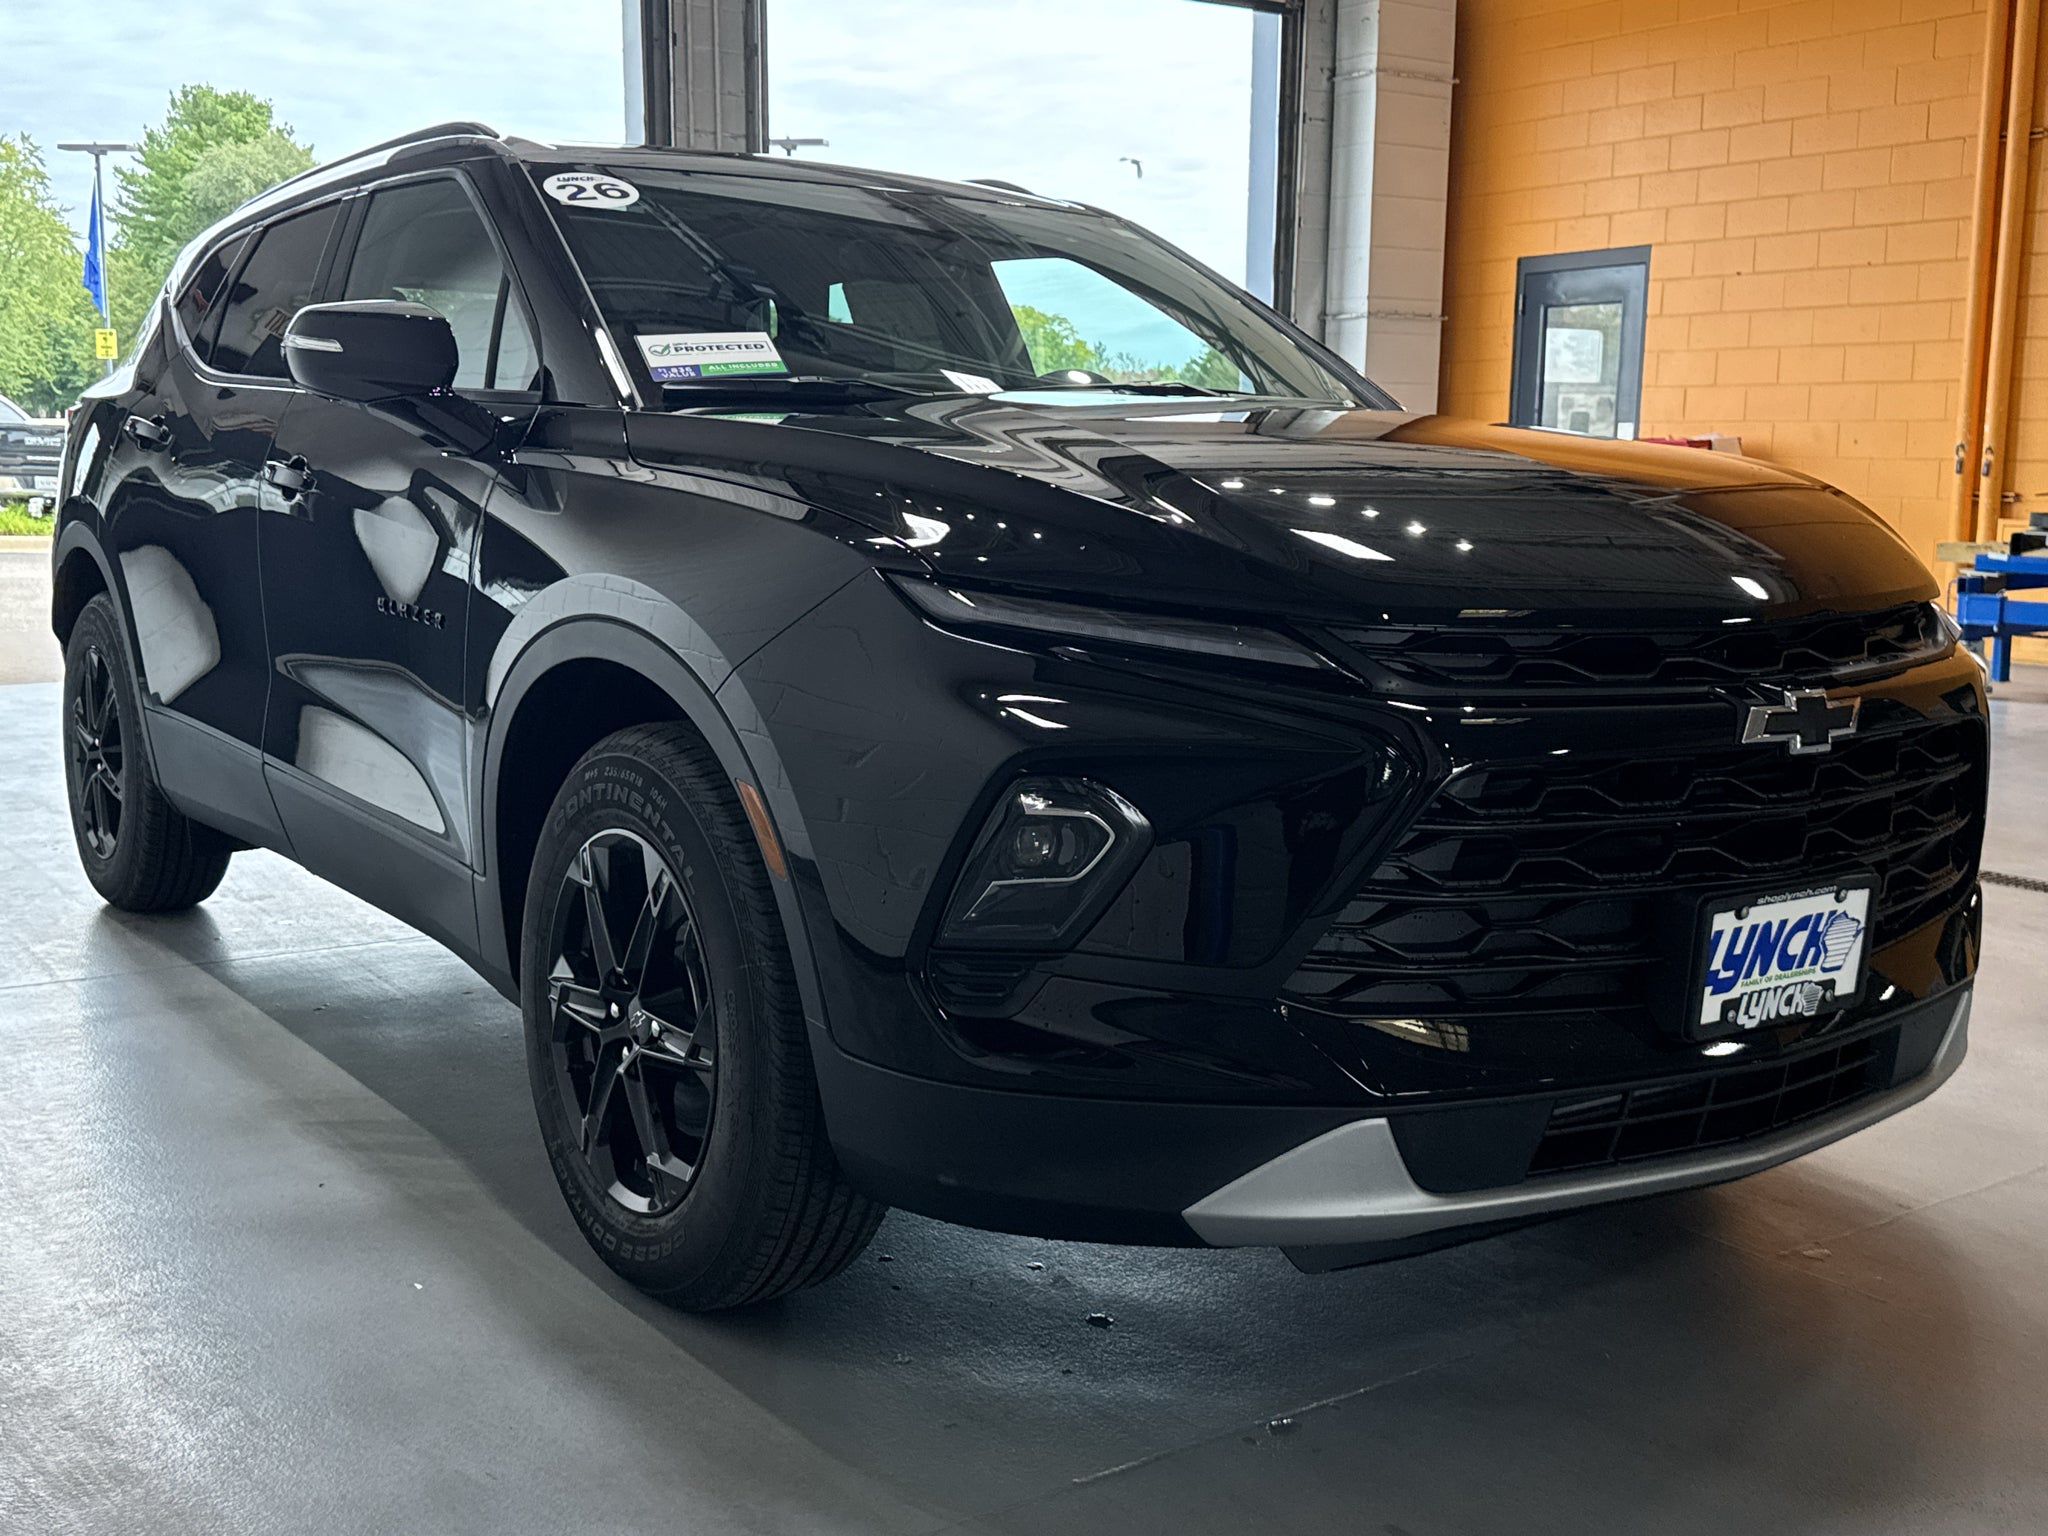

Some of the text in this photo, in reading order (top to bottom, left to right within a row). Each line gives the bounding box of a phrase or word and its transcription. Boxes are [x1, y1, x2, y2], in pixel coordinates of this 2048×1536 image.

[556, 182, 630, 201] 26
[674, 343, 765, 353] PROTECTED
[729, 362, 778, 370] INCLUDED
[554, 782, 695, 895] CONTINENTAL
[1704, 909, 1839, 996] LYNCH
[1741, 977, 1764, 988] FAMILY
[1774, 968, 1816, 981] DEALERSHIPS
[1737, 982, 1807, 1029] LYNCH
